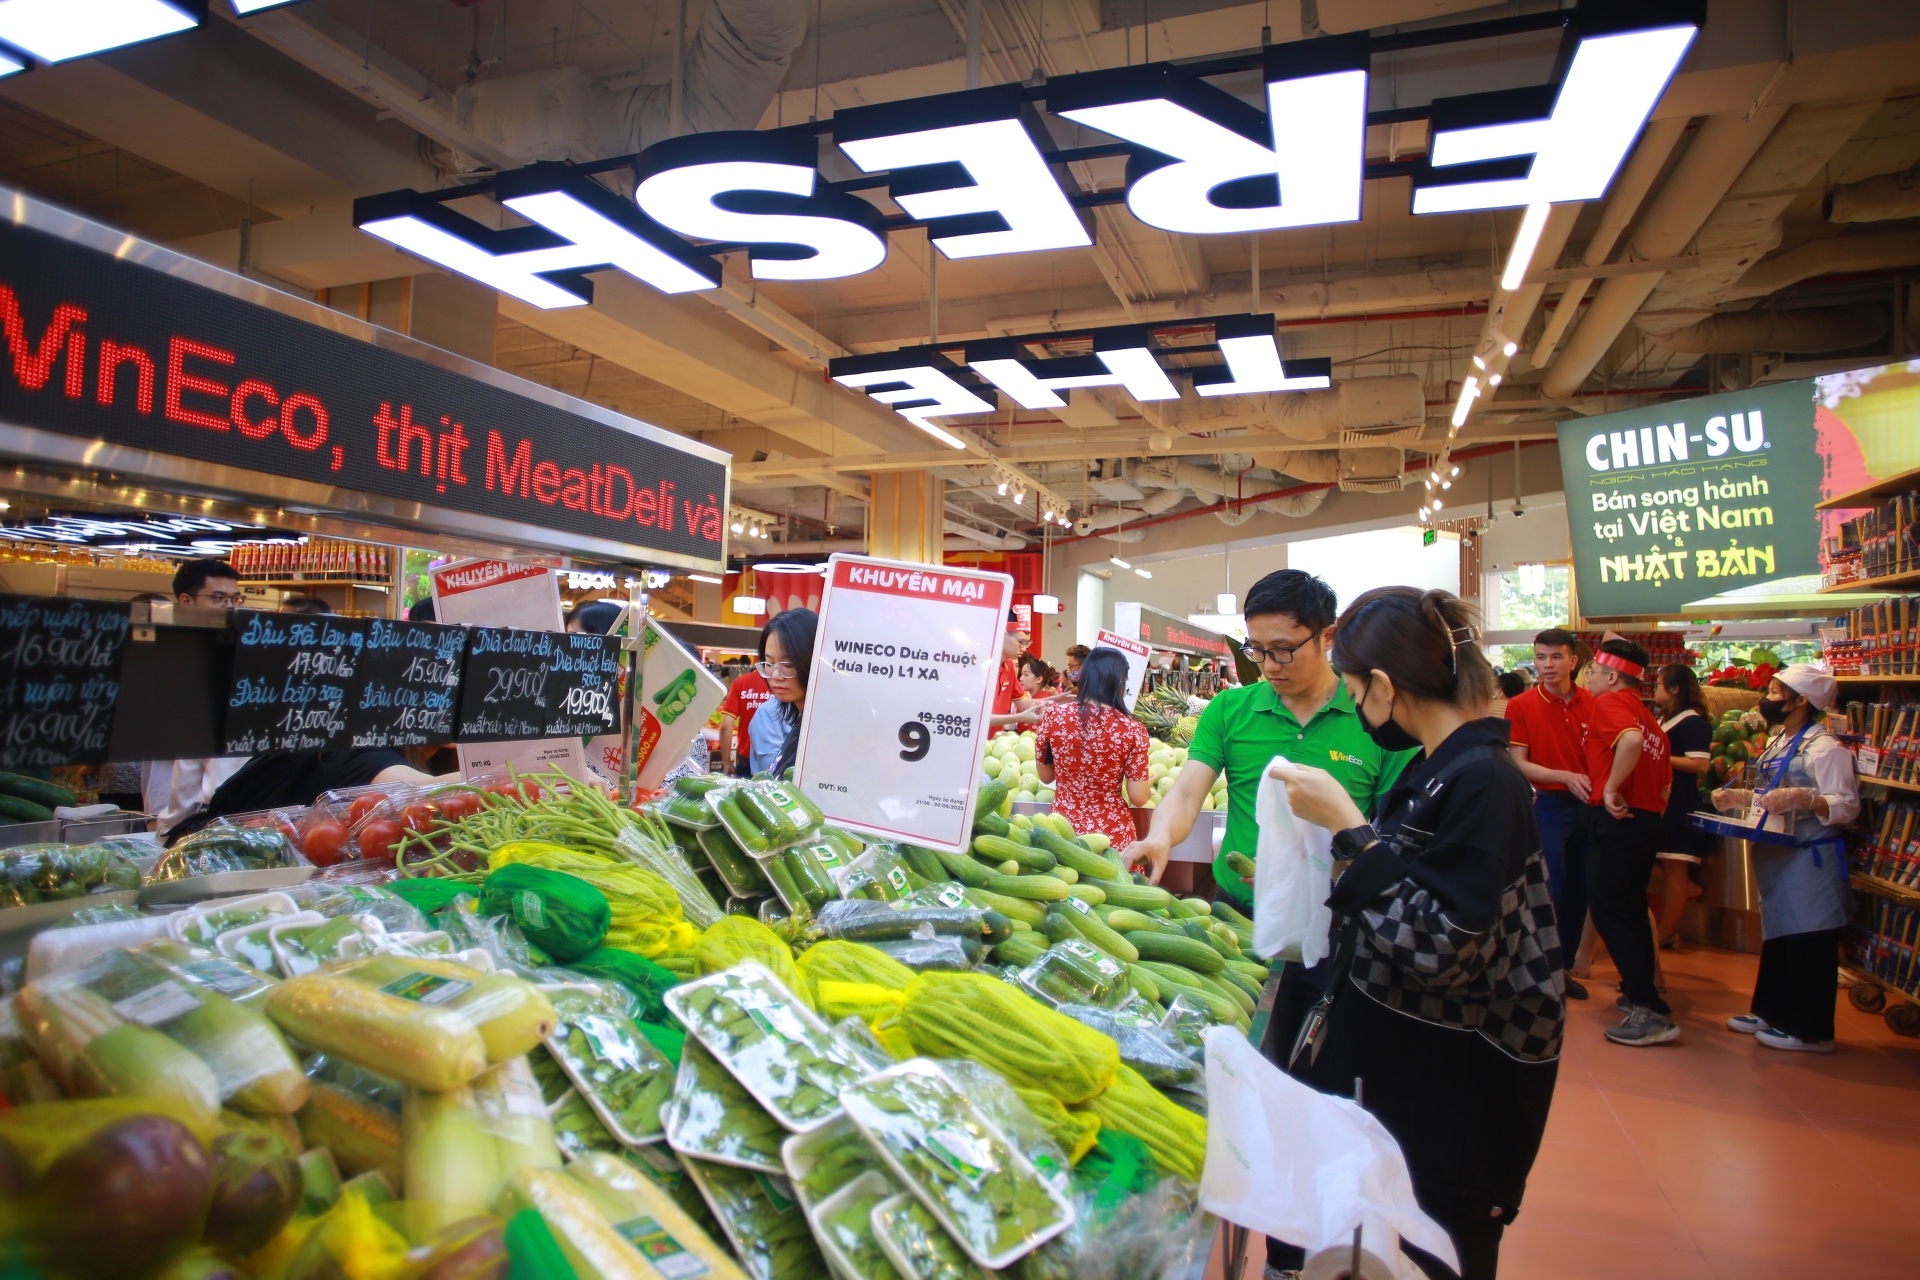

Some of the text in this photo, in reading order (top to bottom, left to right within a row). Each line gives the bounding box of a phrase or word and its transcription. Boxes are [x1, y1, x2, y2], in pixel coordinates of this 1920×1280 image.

[355, 22, 1702, 310] FRESH
[832, 334, 1332, 417] THE
[1585, 410, 1764, 471] CHIN-SU
[373, 401, 471, 494] thịt
[484, 430, 676, 532] MeatDeli
[682, 493, 722, 542] và
[1590, 473, 1645, 486] NGON
[1591, 475, 1770, 513] Bán song hành
[1593, 504, 1775, 544] tại Việt Nam
[1674, 536, 1685, 547] &
[445, 560, 505, 590] KHUYẾN
[1599, 538, 1776, 588] NHẬT BẢN
[849, 566, 986, 603] KHUYẾN MẠI
[241, 614, 287, 648] Đậu
[367, 620, 404, 652] Đậu
[832, 658, 940, 681] (dưa leo) L1 XA
[834, 639, 977, 668] WINECO Dưa chuột
[1329, 749, 1363, 766] WinEco
[818, 782, 848, 793] ĐVT: KG
